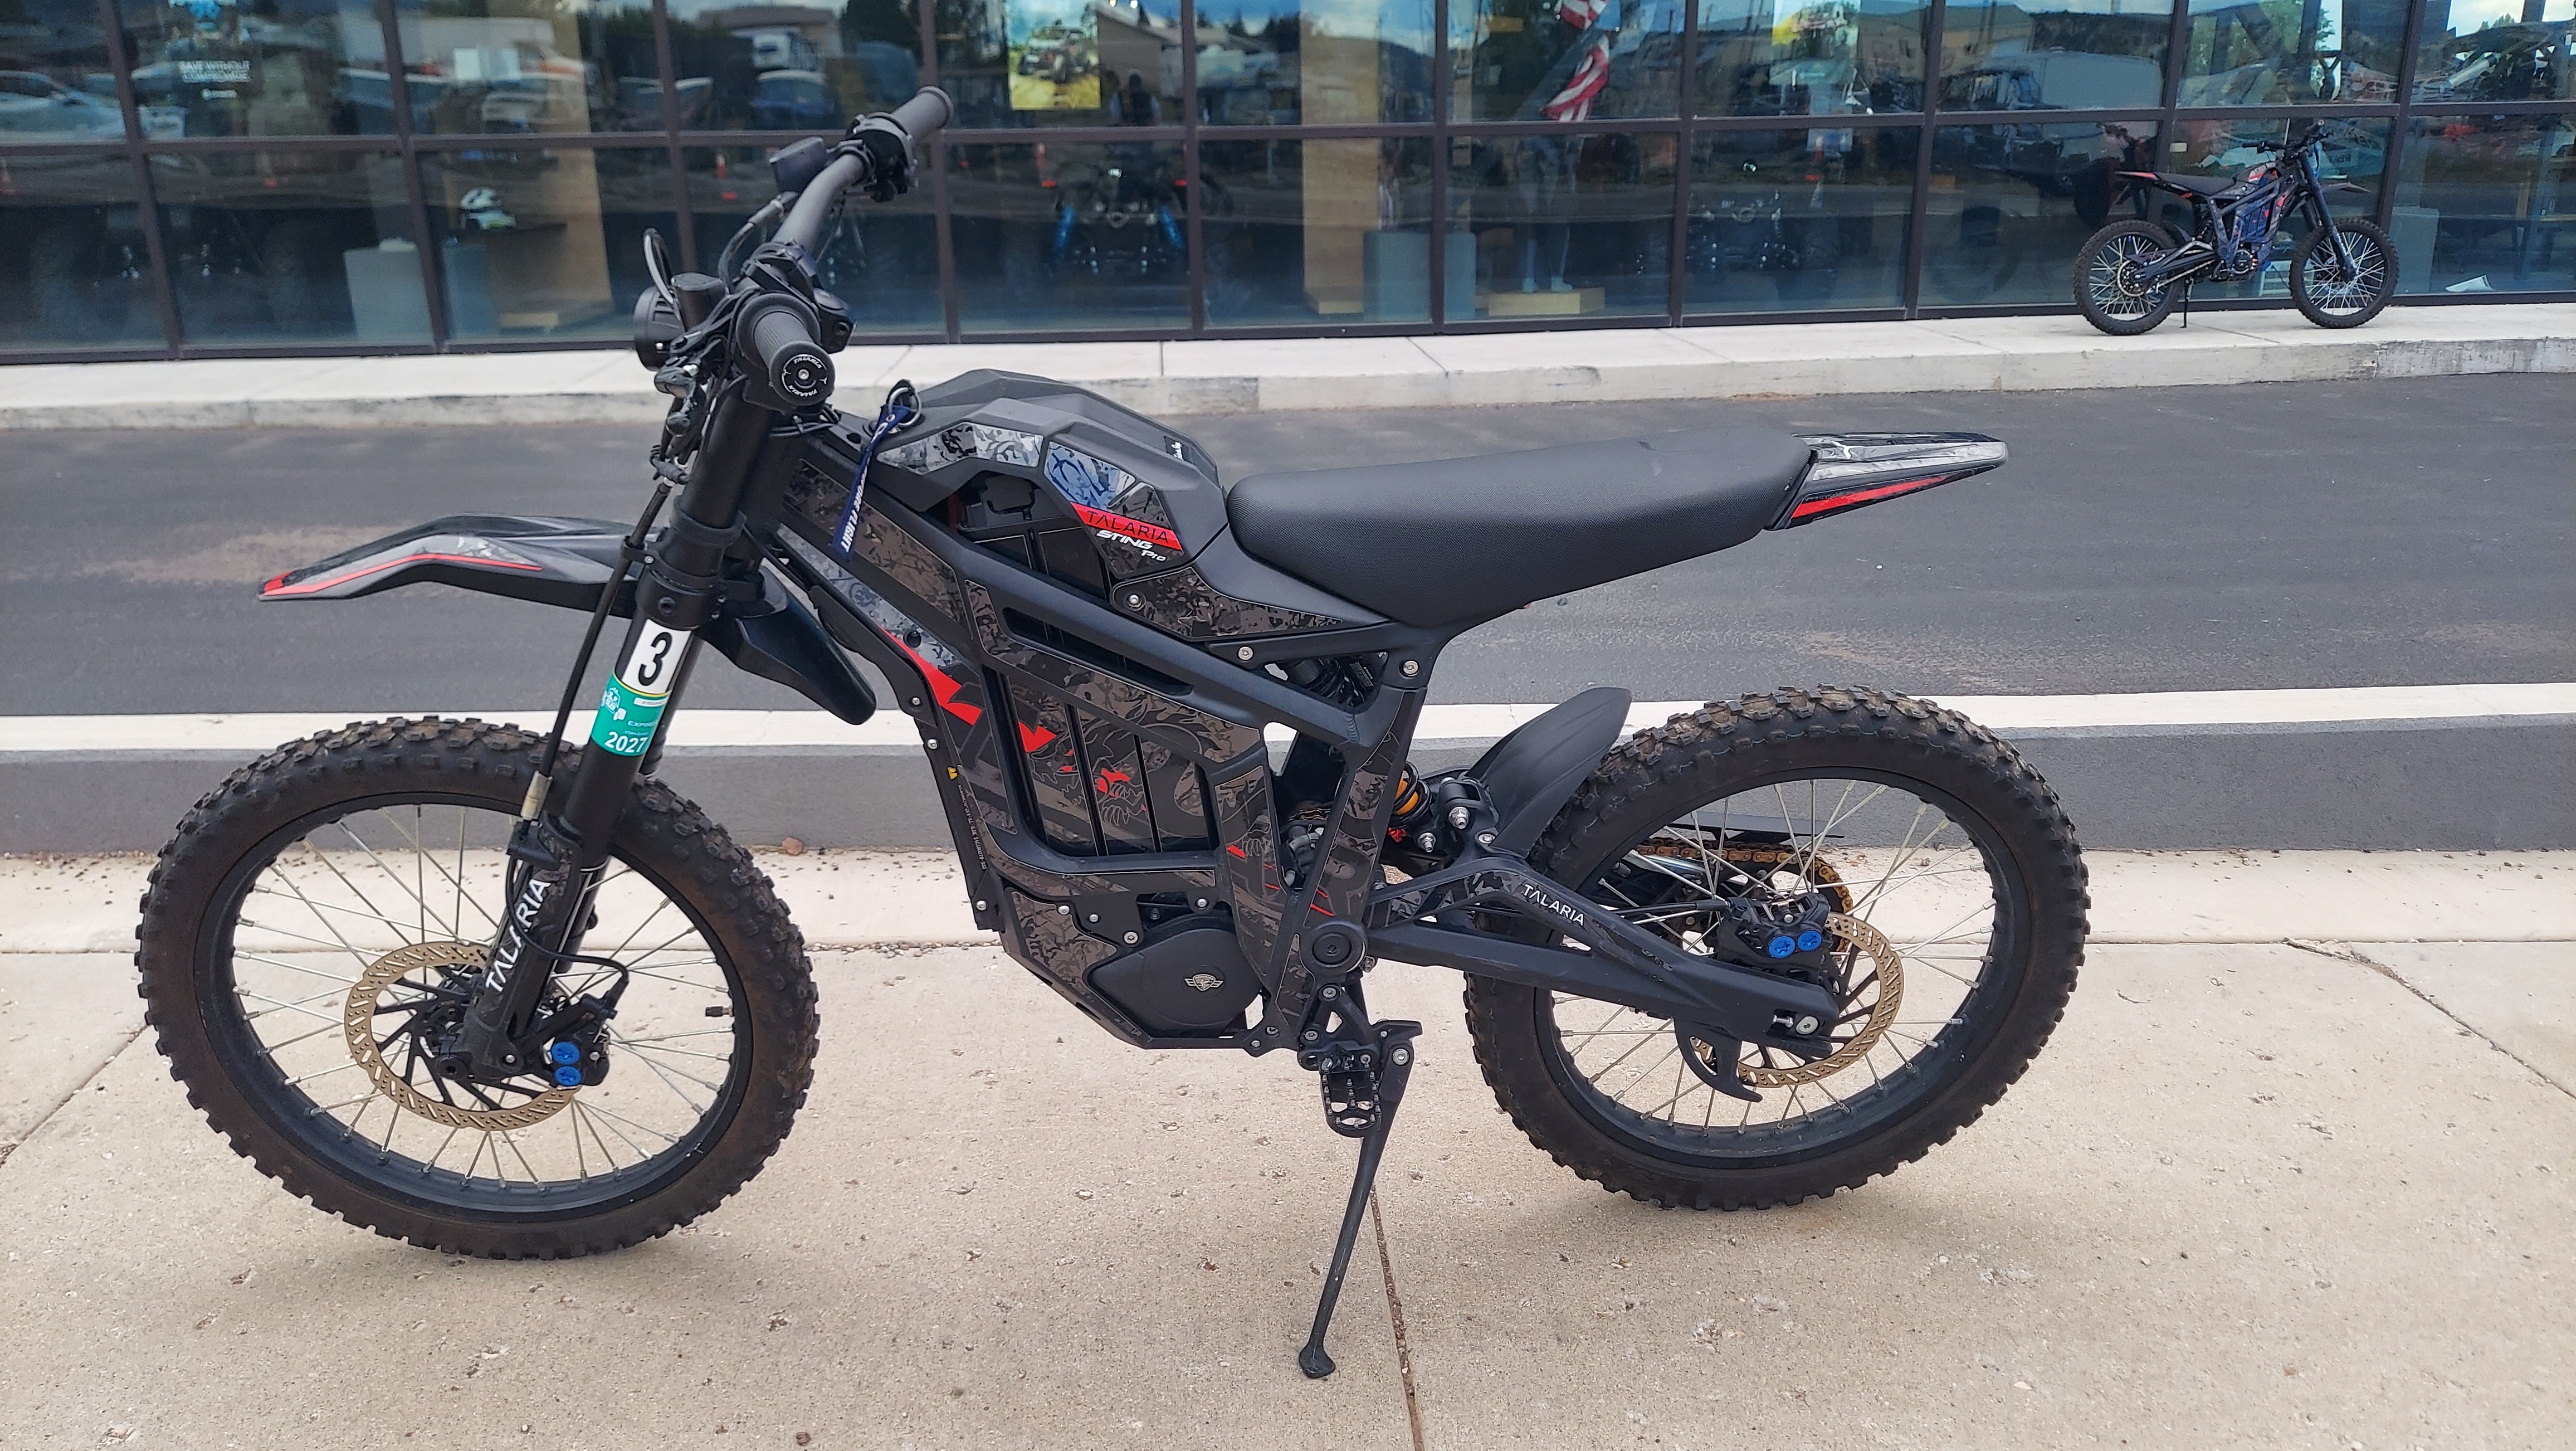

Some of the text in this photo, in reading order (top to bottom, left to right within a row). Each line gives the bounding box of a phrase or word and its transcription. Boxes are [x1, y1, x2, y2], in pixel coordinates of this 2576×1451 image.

[841, 509, 858, 553] FLIGHT
[1087, 510, 1169, 544] TALARIA
[1096, 529, 1153, 549] STING
[638, 631, 673, 686] 3
[604, 731, 648, 753] 2027
[1524, 884, 1584, 926] TALARIA
